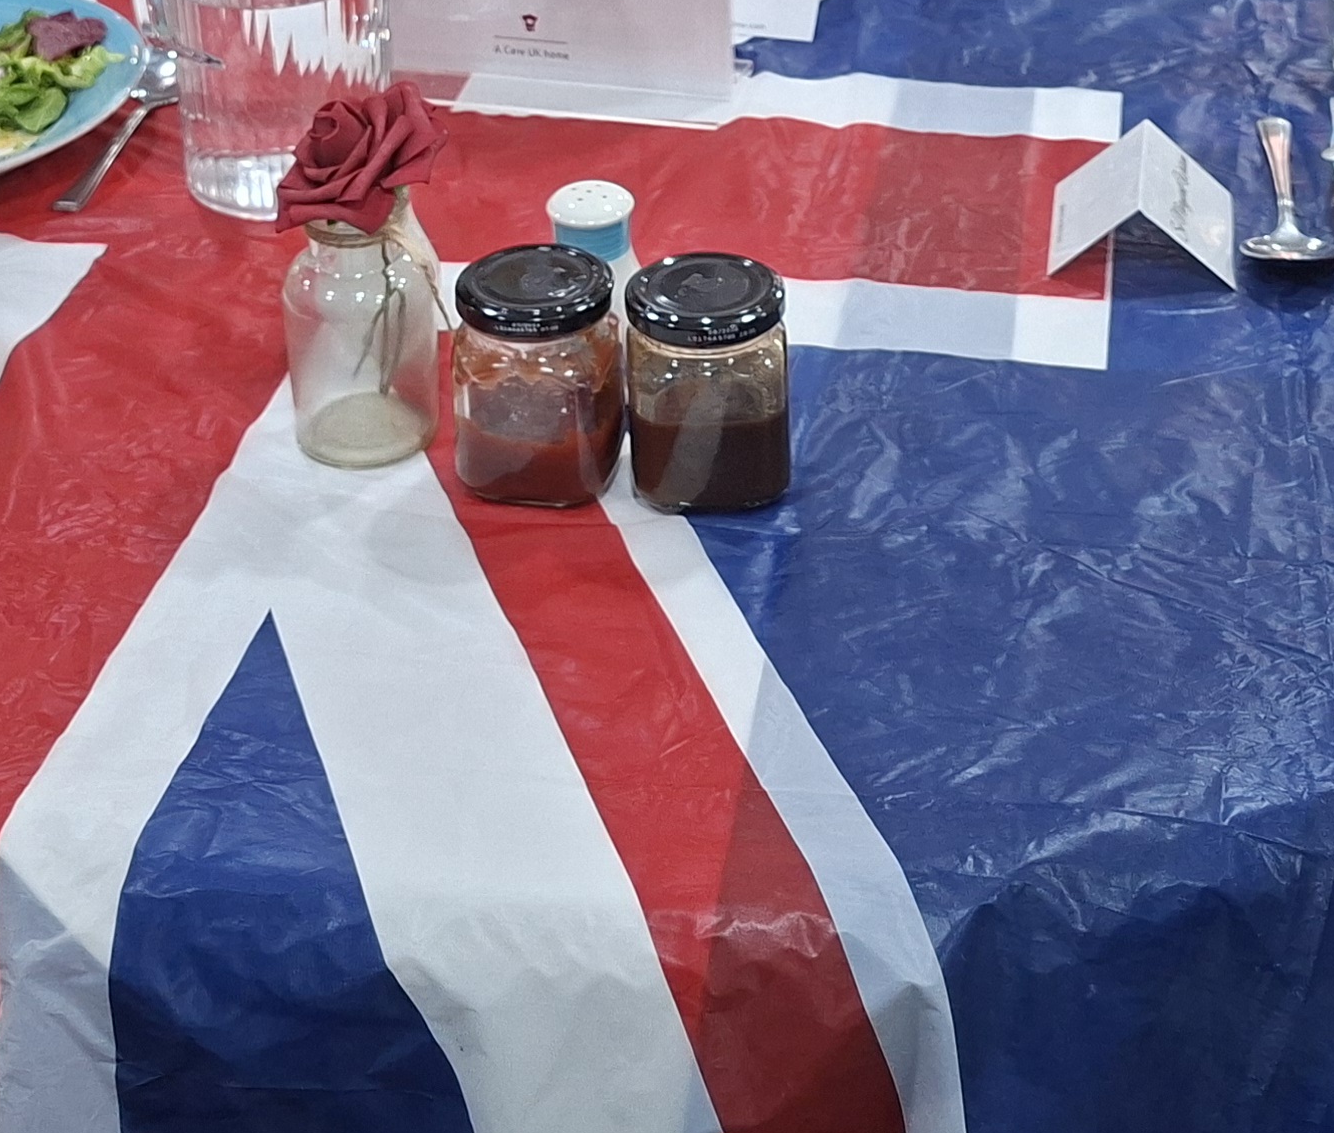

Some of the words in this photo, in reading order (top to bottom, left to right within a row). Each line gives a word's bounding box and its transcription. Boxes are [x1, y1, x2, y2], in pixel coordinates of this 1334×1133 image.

[494, 44, 502, 54] A
[503, 45, 526, 57] Care
[528, 47, 542, 57] UK
[544, 49, 570, 60] home
